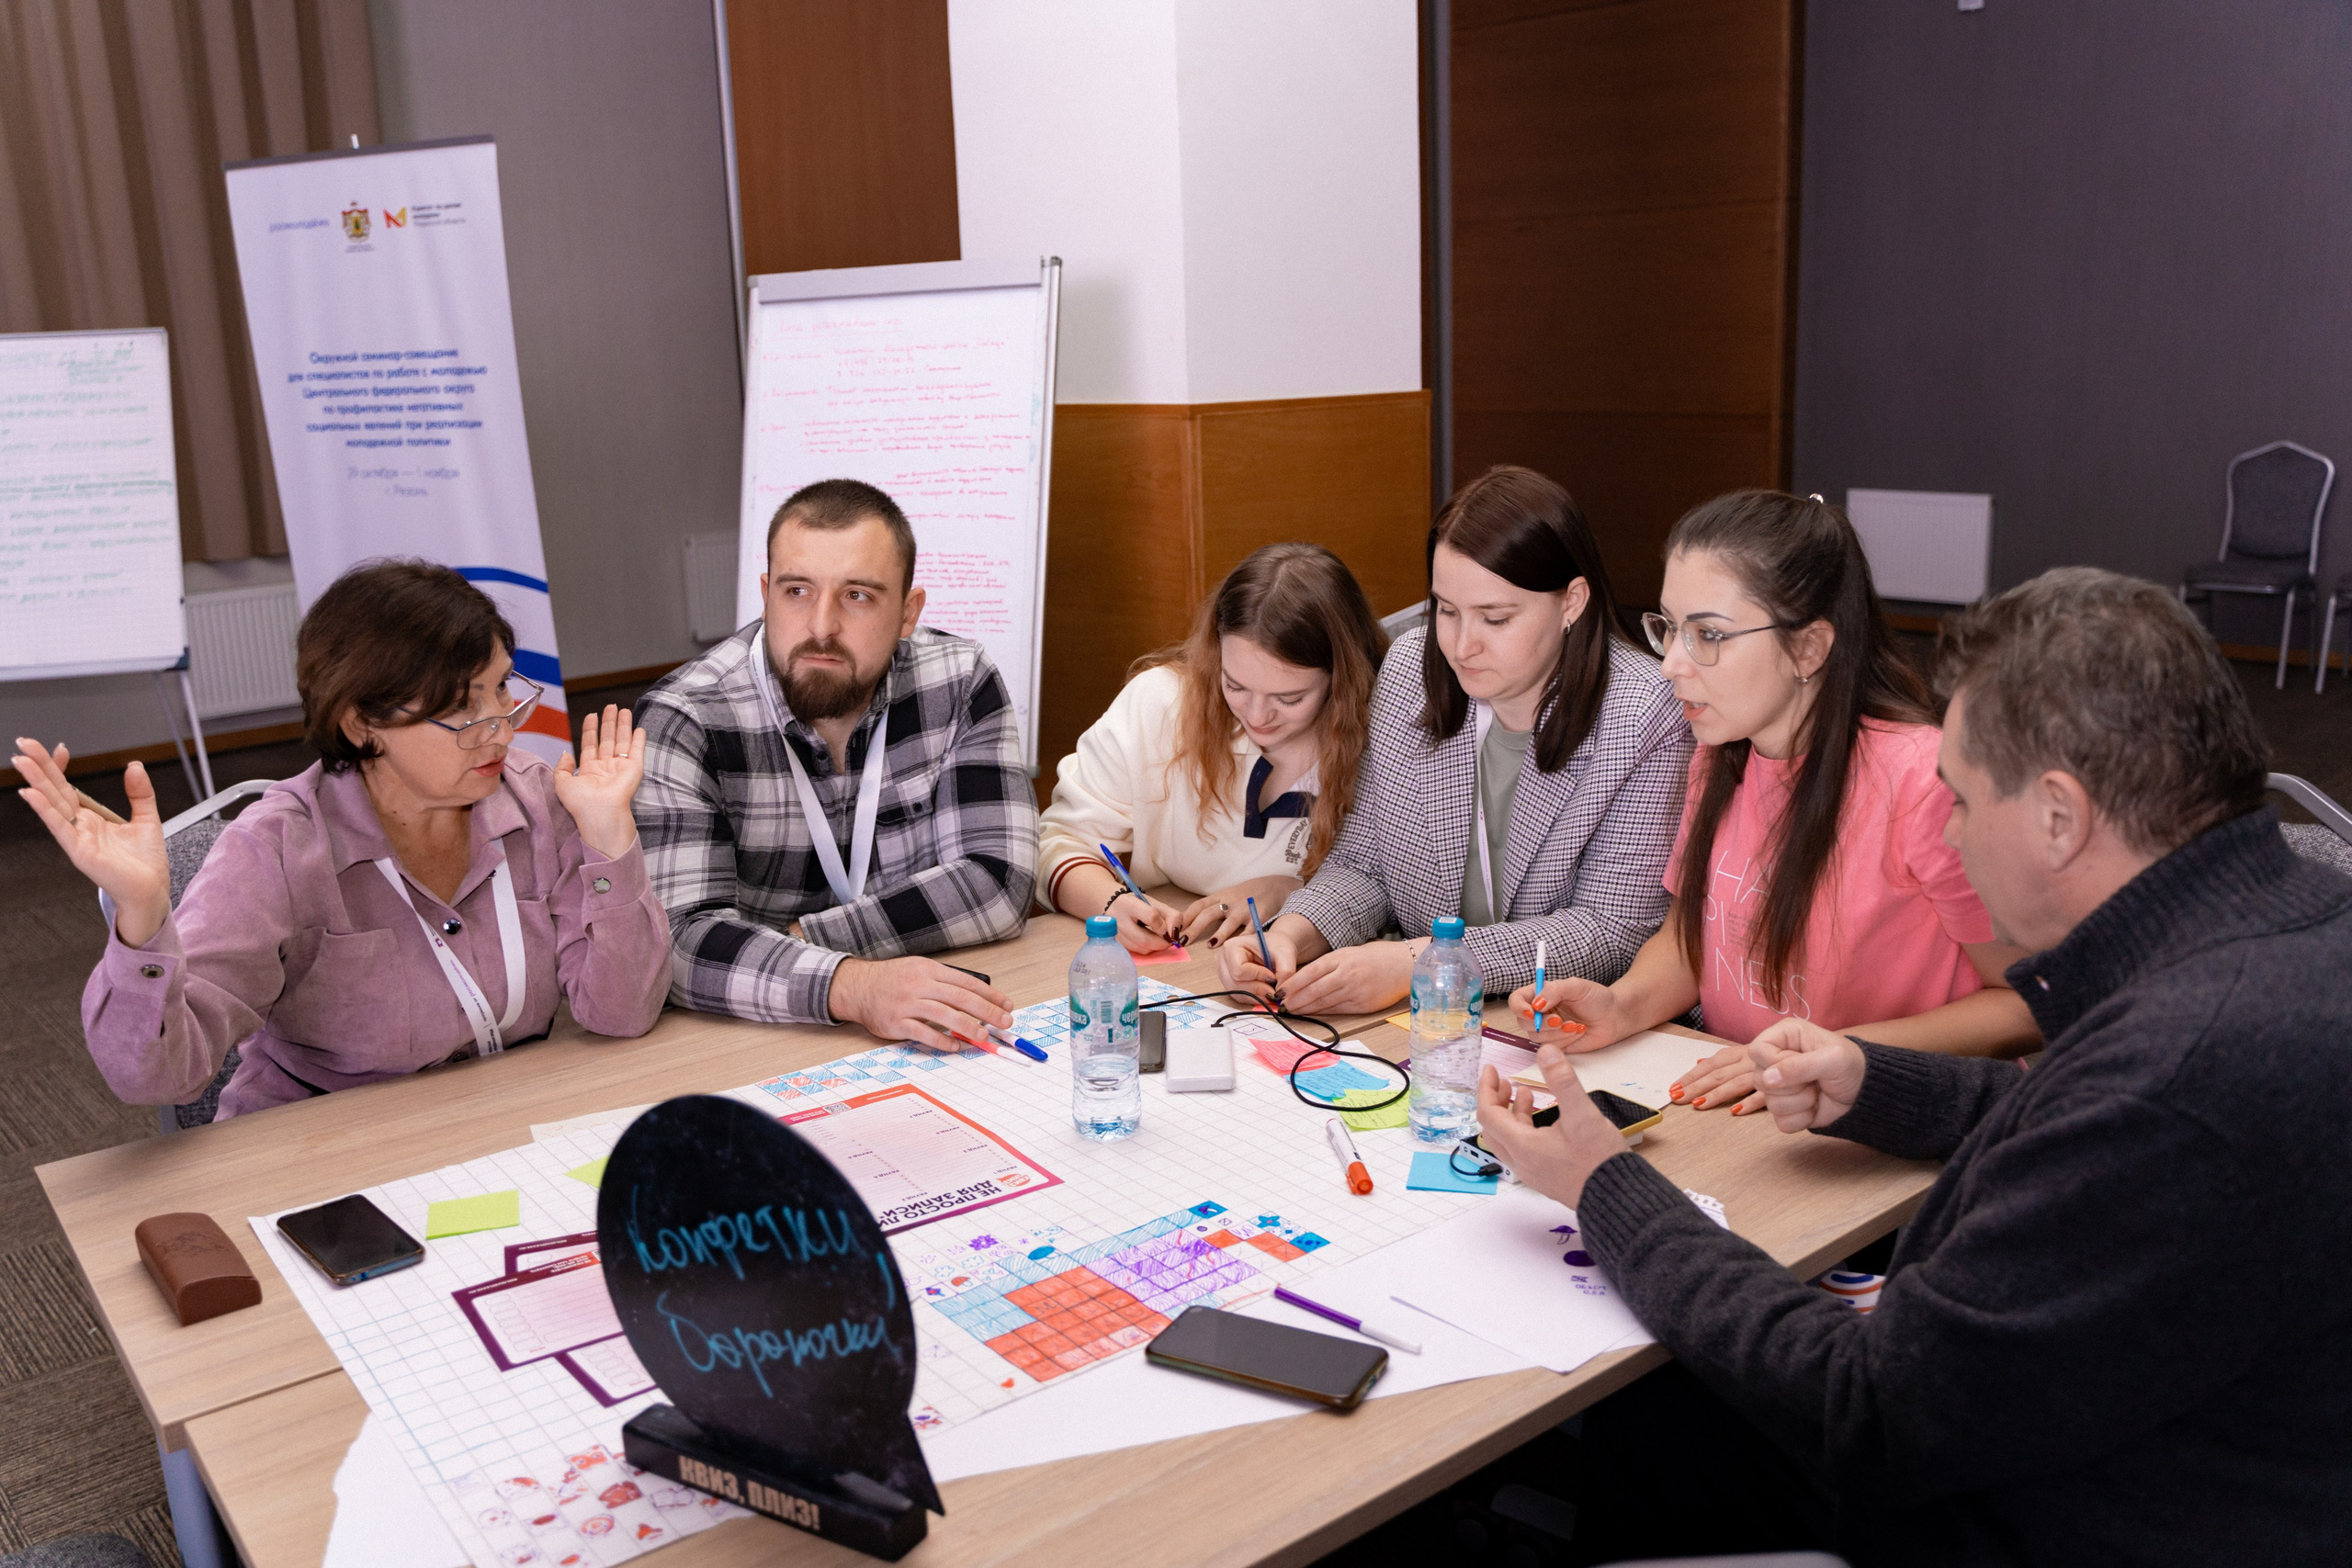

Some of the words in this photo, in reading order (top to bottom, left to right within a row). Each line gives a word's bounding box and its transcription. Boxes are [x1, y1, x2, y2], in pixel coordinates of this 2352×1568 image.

[956, 1179, 991, 1195] ДЛЯ
[981, 1186, 1002, 1198] НЕ
[903, 1192, 978, 1220] ПРОСТО
[678, 1455, 745, 1505] КВИЗ,
[747, 1480, 820, 1531] ПЛИЗ!
